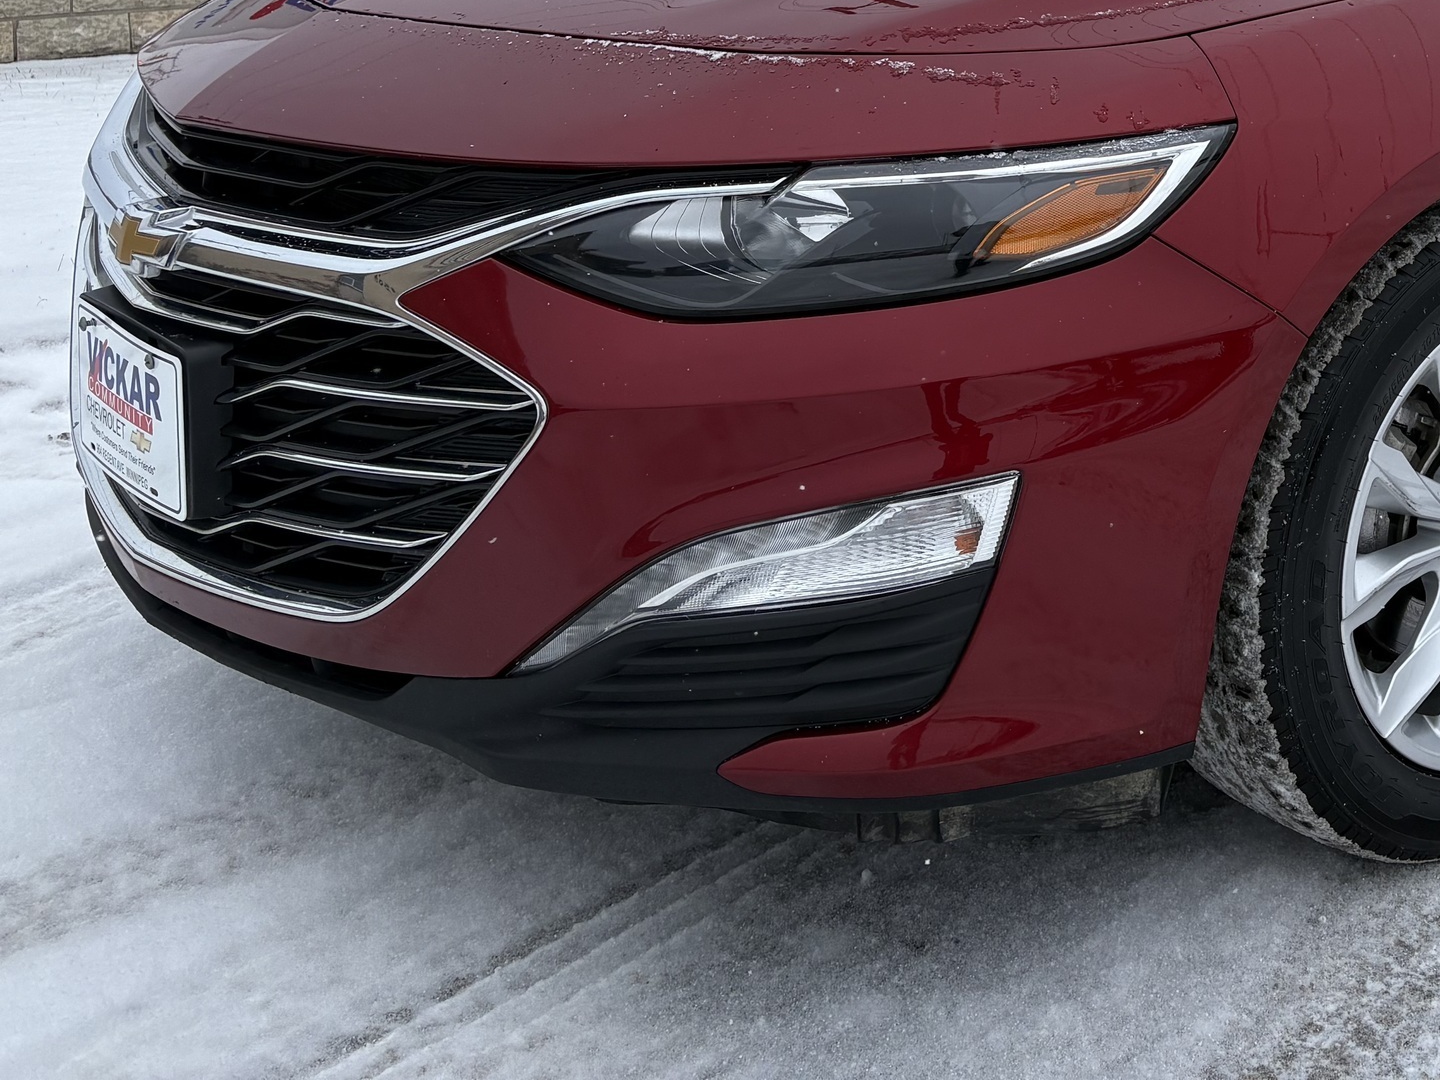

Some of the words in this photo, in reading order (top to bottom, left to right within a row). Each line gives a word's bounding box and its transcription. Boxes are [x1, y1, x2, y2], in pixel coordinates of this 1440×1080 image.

[86, 330, 163, 422] VICKAR
[88, 376, 153, 432] COMMUNITY
[86, 394, 126, 440] CHEVROLET
